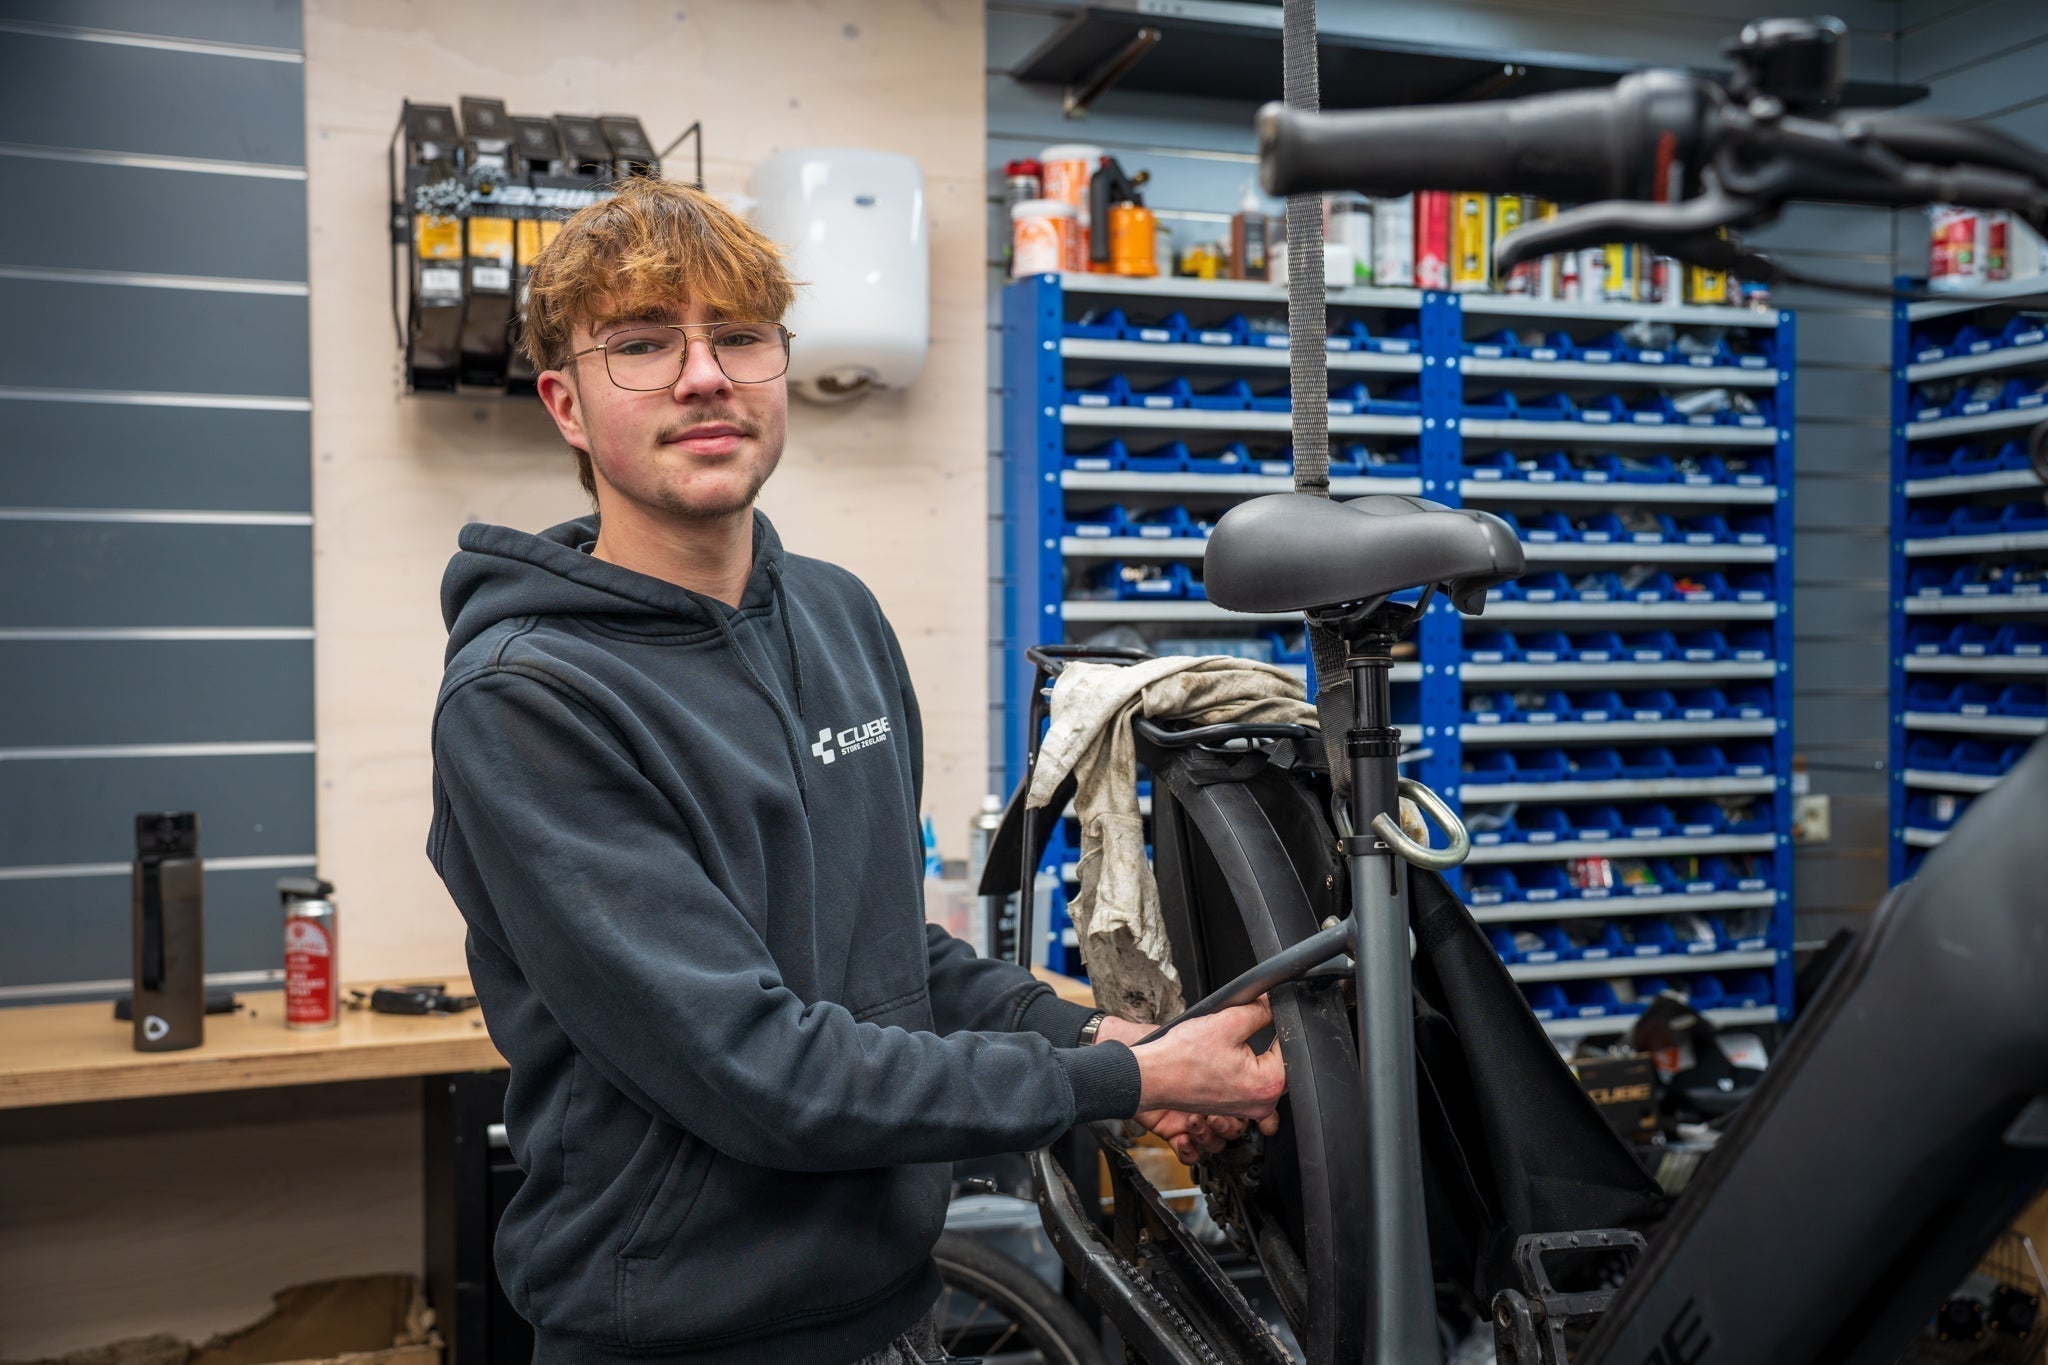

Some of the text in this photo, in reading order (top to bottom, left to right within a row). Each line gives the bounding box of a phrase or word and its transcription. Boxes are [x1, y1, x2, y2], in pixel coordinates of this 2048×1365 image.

[837, 717, 891, 747] CUBE
[841, 733, 887, 755] STORE ZEELAND
